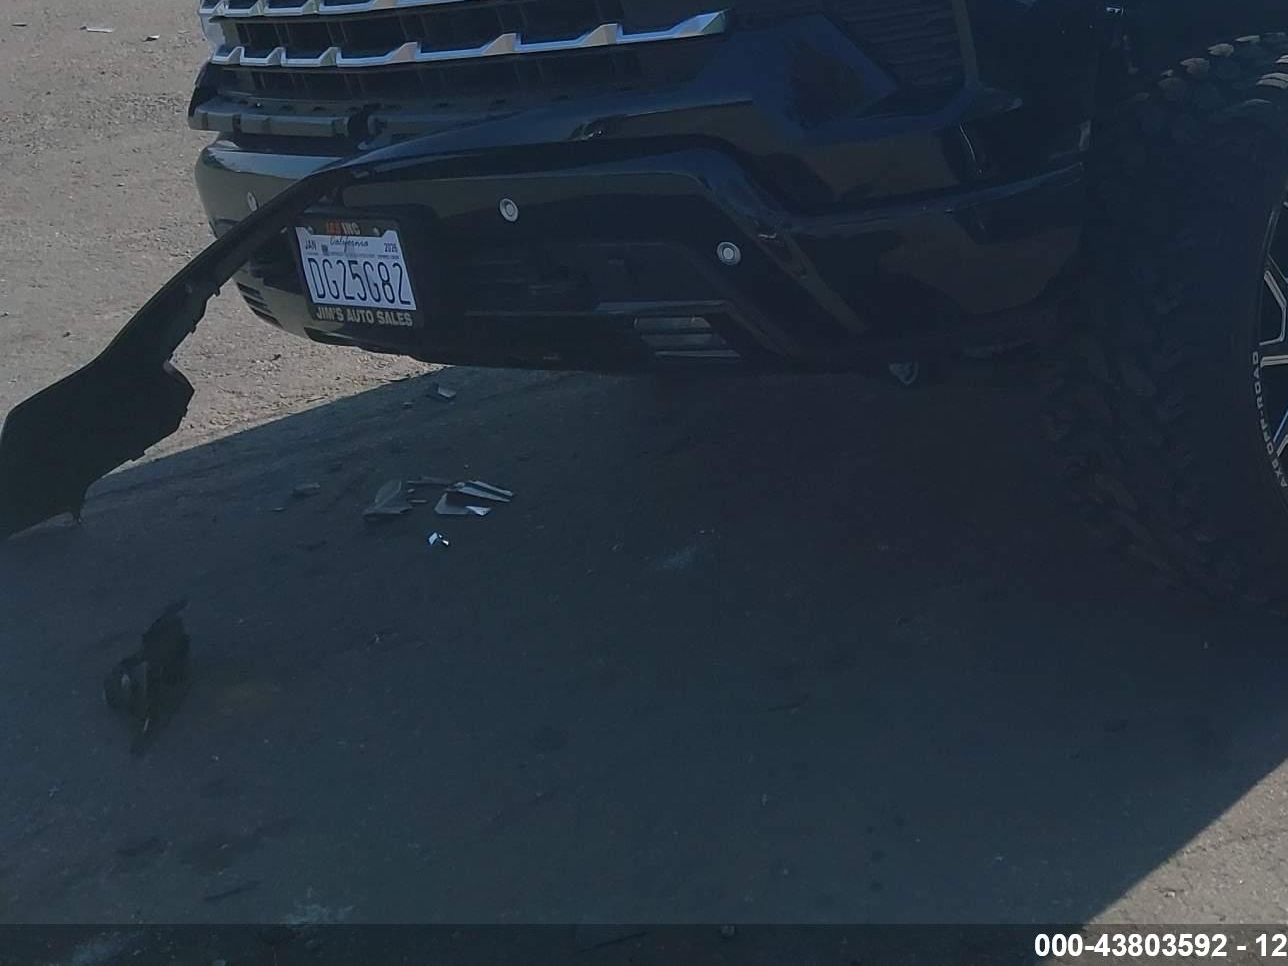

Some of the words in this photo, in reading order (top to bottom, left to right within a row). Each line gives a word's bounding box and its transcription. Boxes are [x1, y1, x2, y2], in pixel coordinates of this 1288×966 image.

[305, 240, 317, 251] JAN
[307, 257, 411, 306] DG25G82
[316, 306, 344, 322] JIM'S
[346, 308, 375, 324] AUTO
[376, 310, 414, 327] SALES
